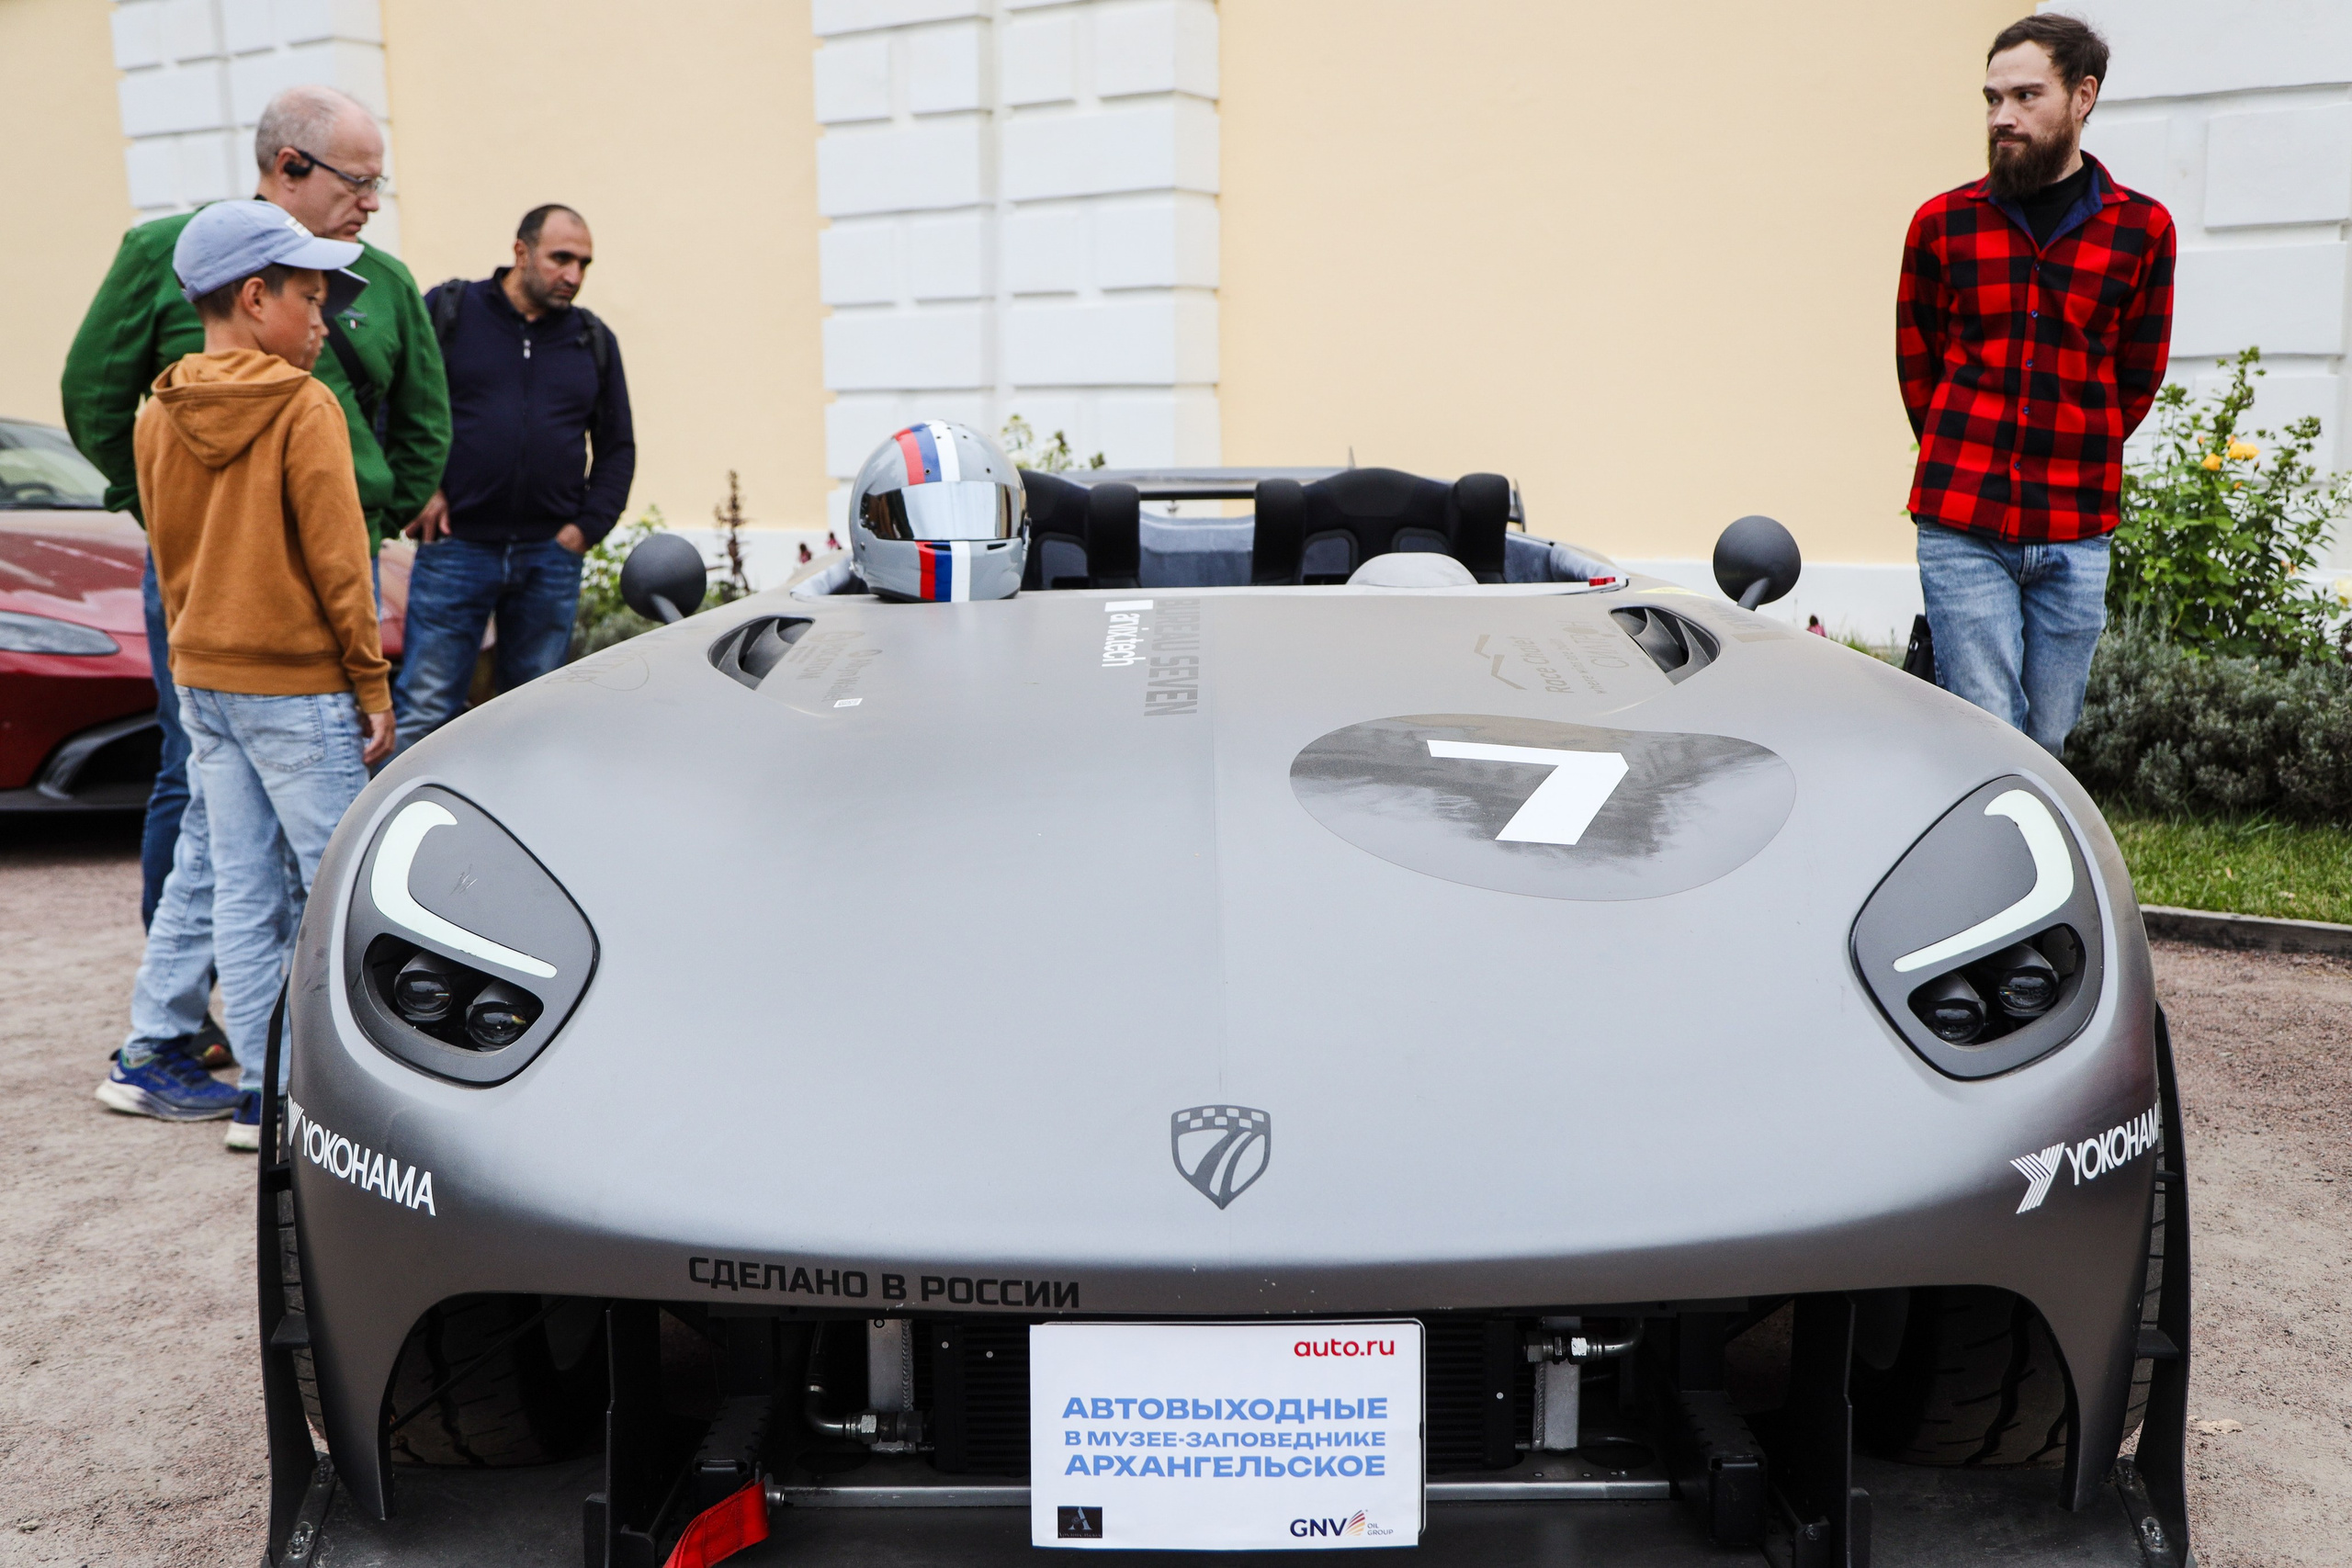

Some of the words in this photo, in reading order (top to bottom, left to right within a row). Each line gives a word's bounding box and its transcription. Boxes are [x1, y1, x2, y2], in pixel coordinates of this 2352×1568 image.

[1102, 613, 1149, 667] arvix.tech
[1151, 599, 1201, 651] BUREAU
[1144, 655, 1200, 716] SEVEN
[1535, 667, 1575, 694] Race
[1427, 739, 1630, 845] 7
[301, 1114, 436, 1216] YOKOHAMA
[2064, 1100, 2158, 1186] YOKOHAM
[688, 1256, 868, 1298] СДЕЛАНО
[882, 1272, 907, 1301] В
[921, 1275, 1080, 1308] РОССИИ
[1294, 1337, 1396, 1358] auto.ru
[1061, 1396, 1388, 1425] АВТОВЫХОДНЫЕ
[1064, 1430, 1082, 1446] В
[1087, 1430, 1386, 1450] МУЗЕЕ-ЗАПОВЕДНИКЕ
[1064, 1454, 1386, 1478] АРХАНГЕЛЬСКОЕ
[1289, 1518, 1348, 1538] GNV
